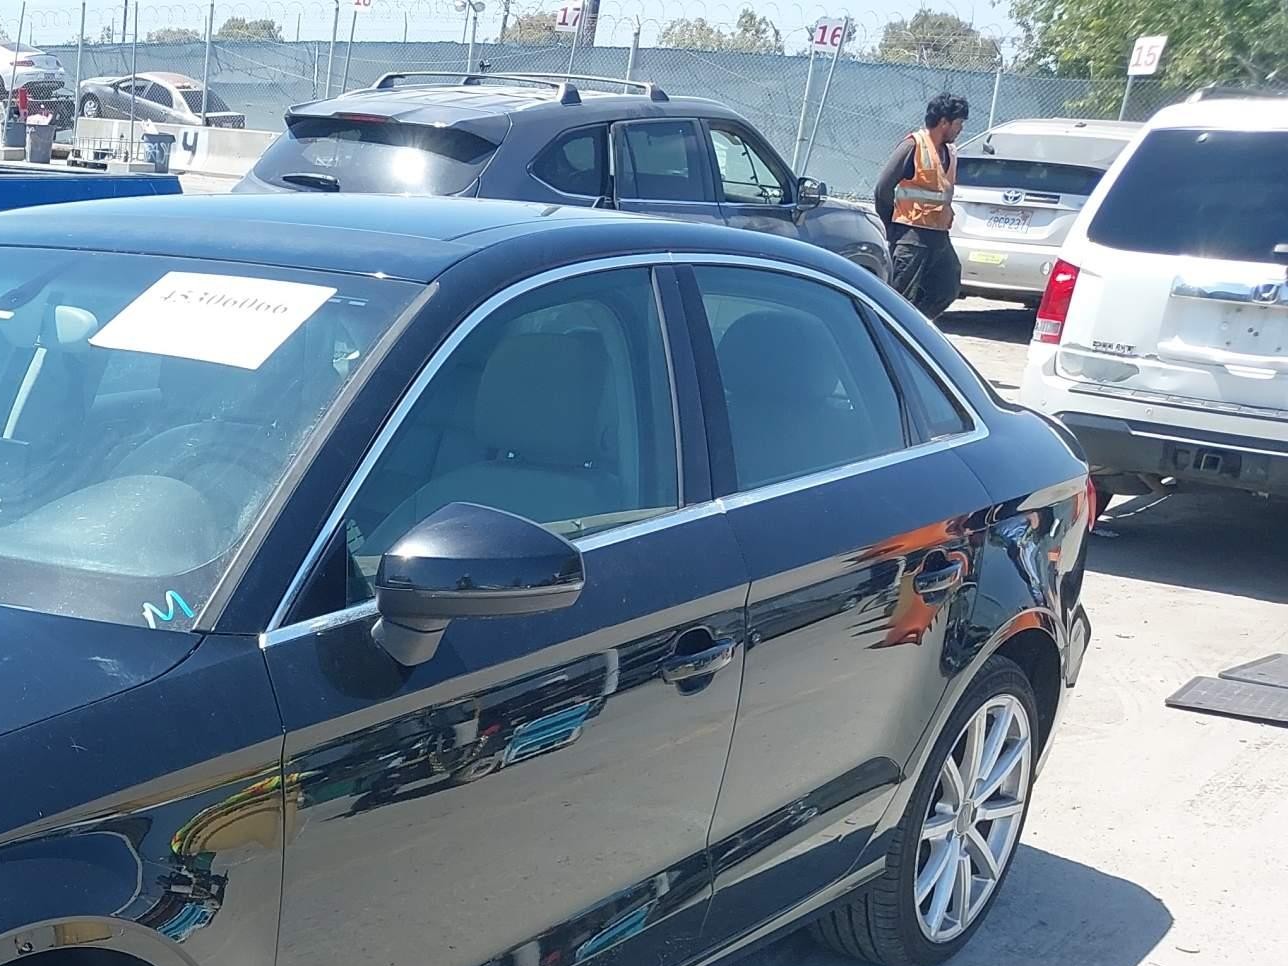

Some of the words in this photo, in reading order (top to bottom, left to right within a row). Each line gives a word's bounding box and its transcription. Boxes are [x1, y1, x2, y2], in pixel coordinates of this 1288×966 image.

[558, 7, 581, 27] 17
[815, 25, 843, 47] 16
[1132, 45, 1160, 67] 15
[182, 131, 199, 165] 4
[142, 590, 194, 629] M
